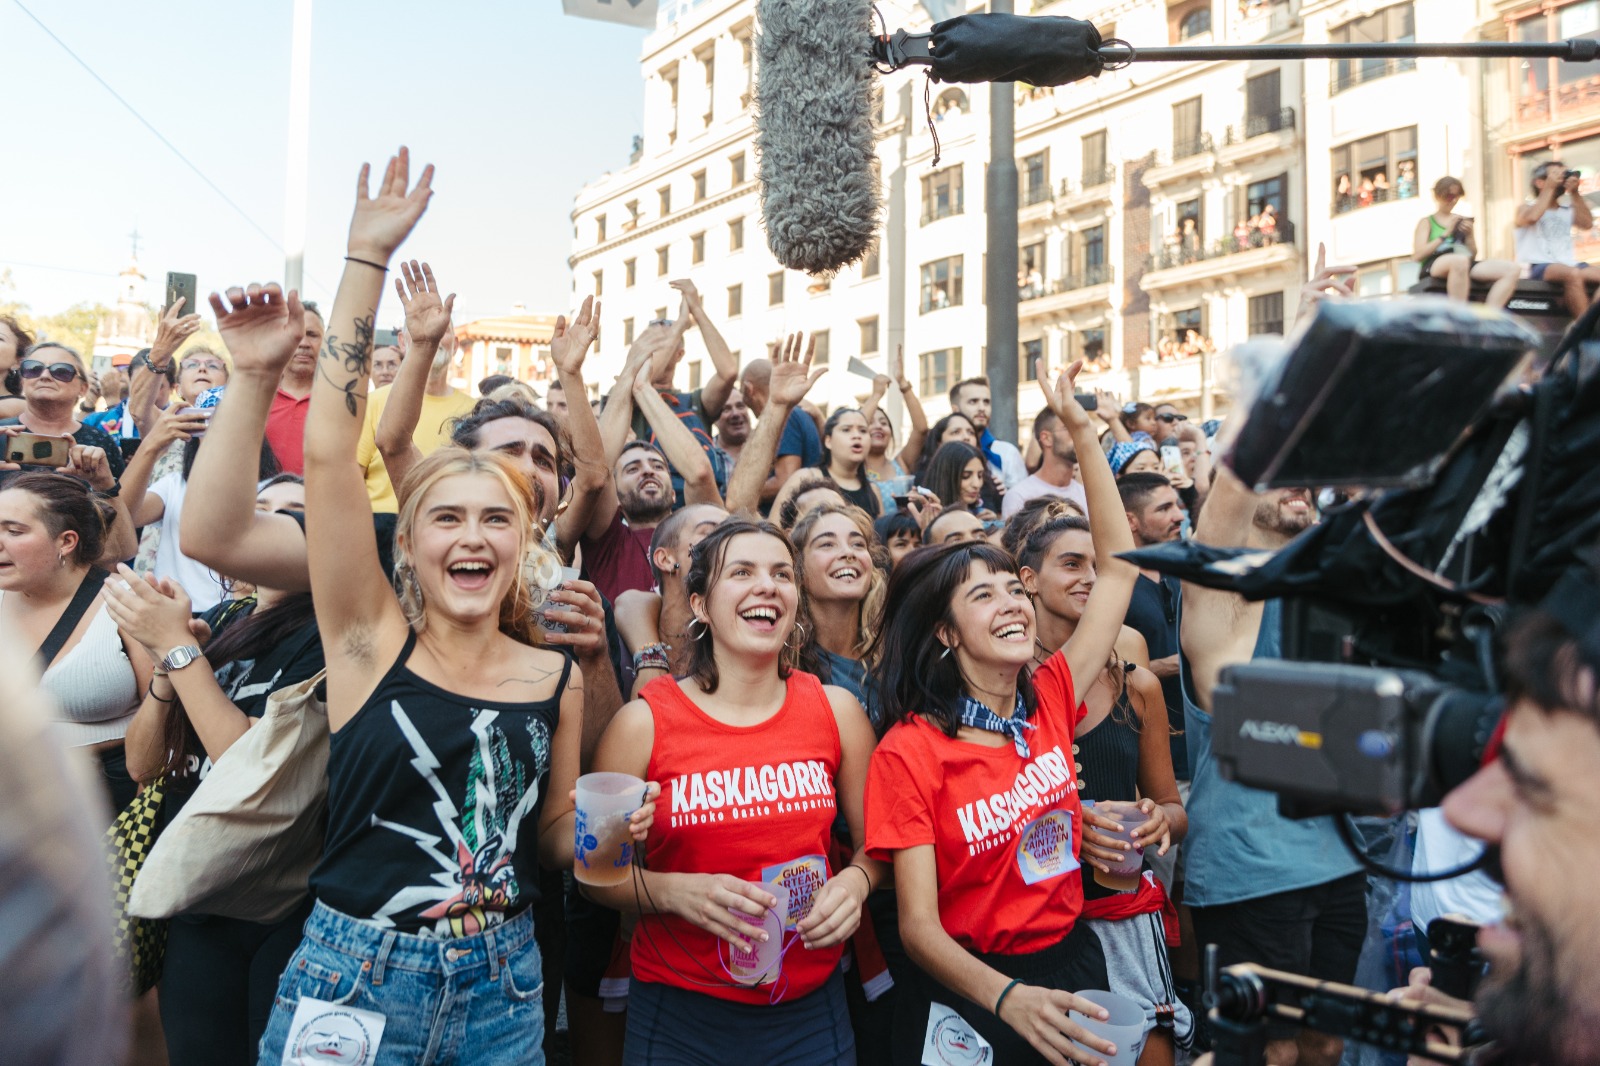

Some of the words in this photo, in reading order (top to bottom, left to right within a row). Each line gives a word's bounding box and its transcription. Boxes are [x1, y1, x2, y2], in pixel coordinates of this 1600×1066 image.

[671, 811, 725, 828] Bilboko
[969, 833, 1012, 857] Bilboko
[783, 862, 812, 879] GURE
